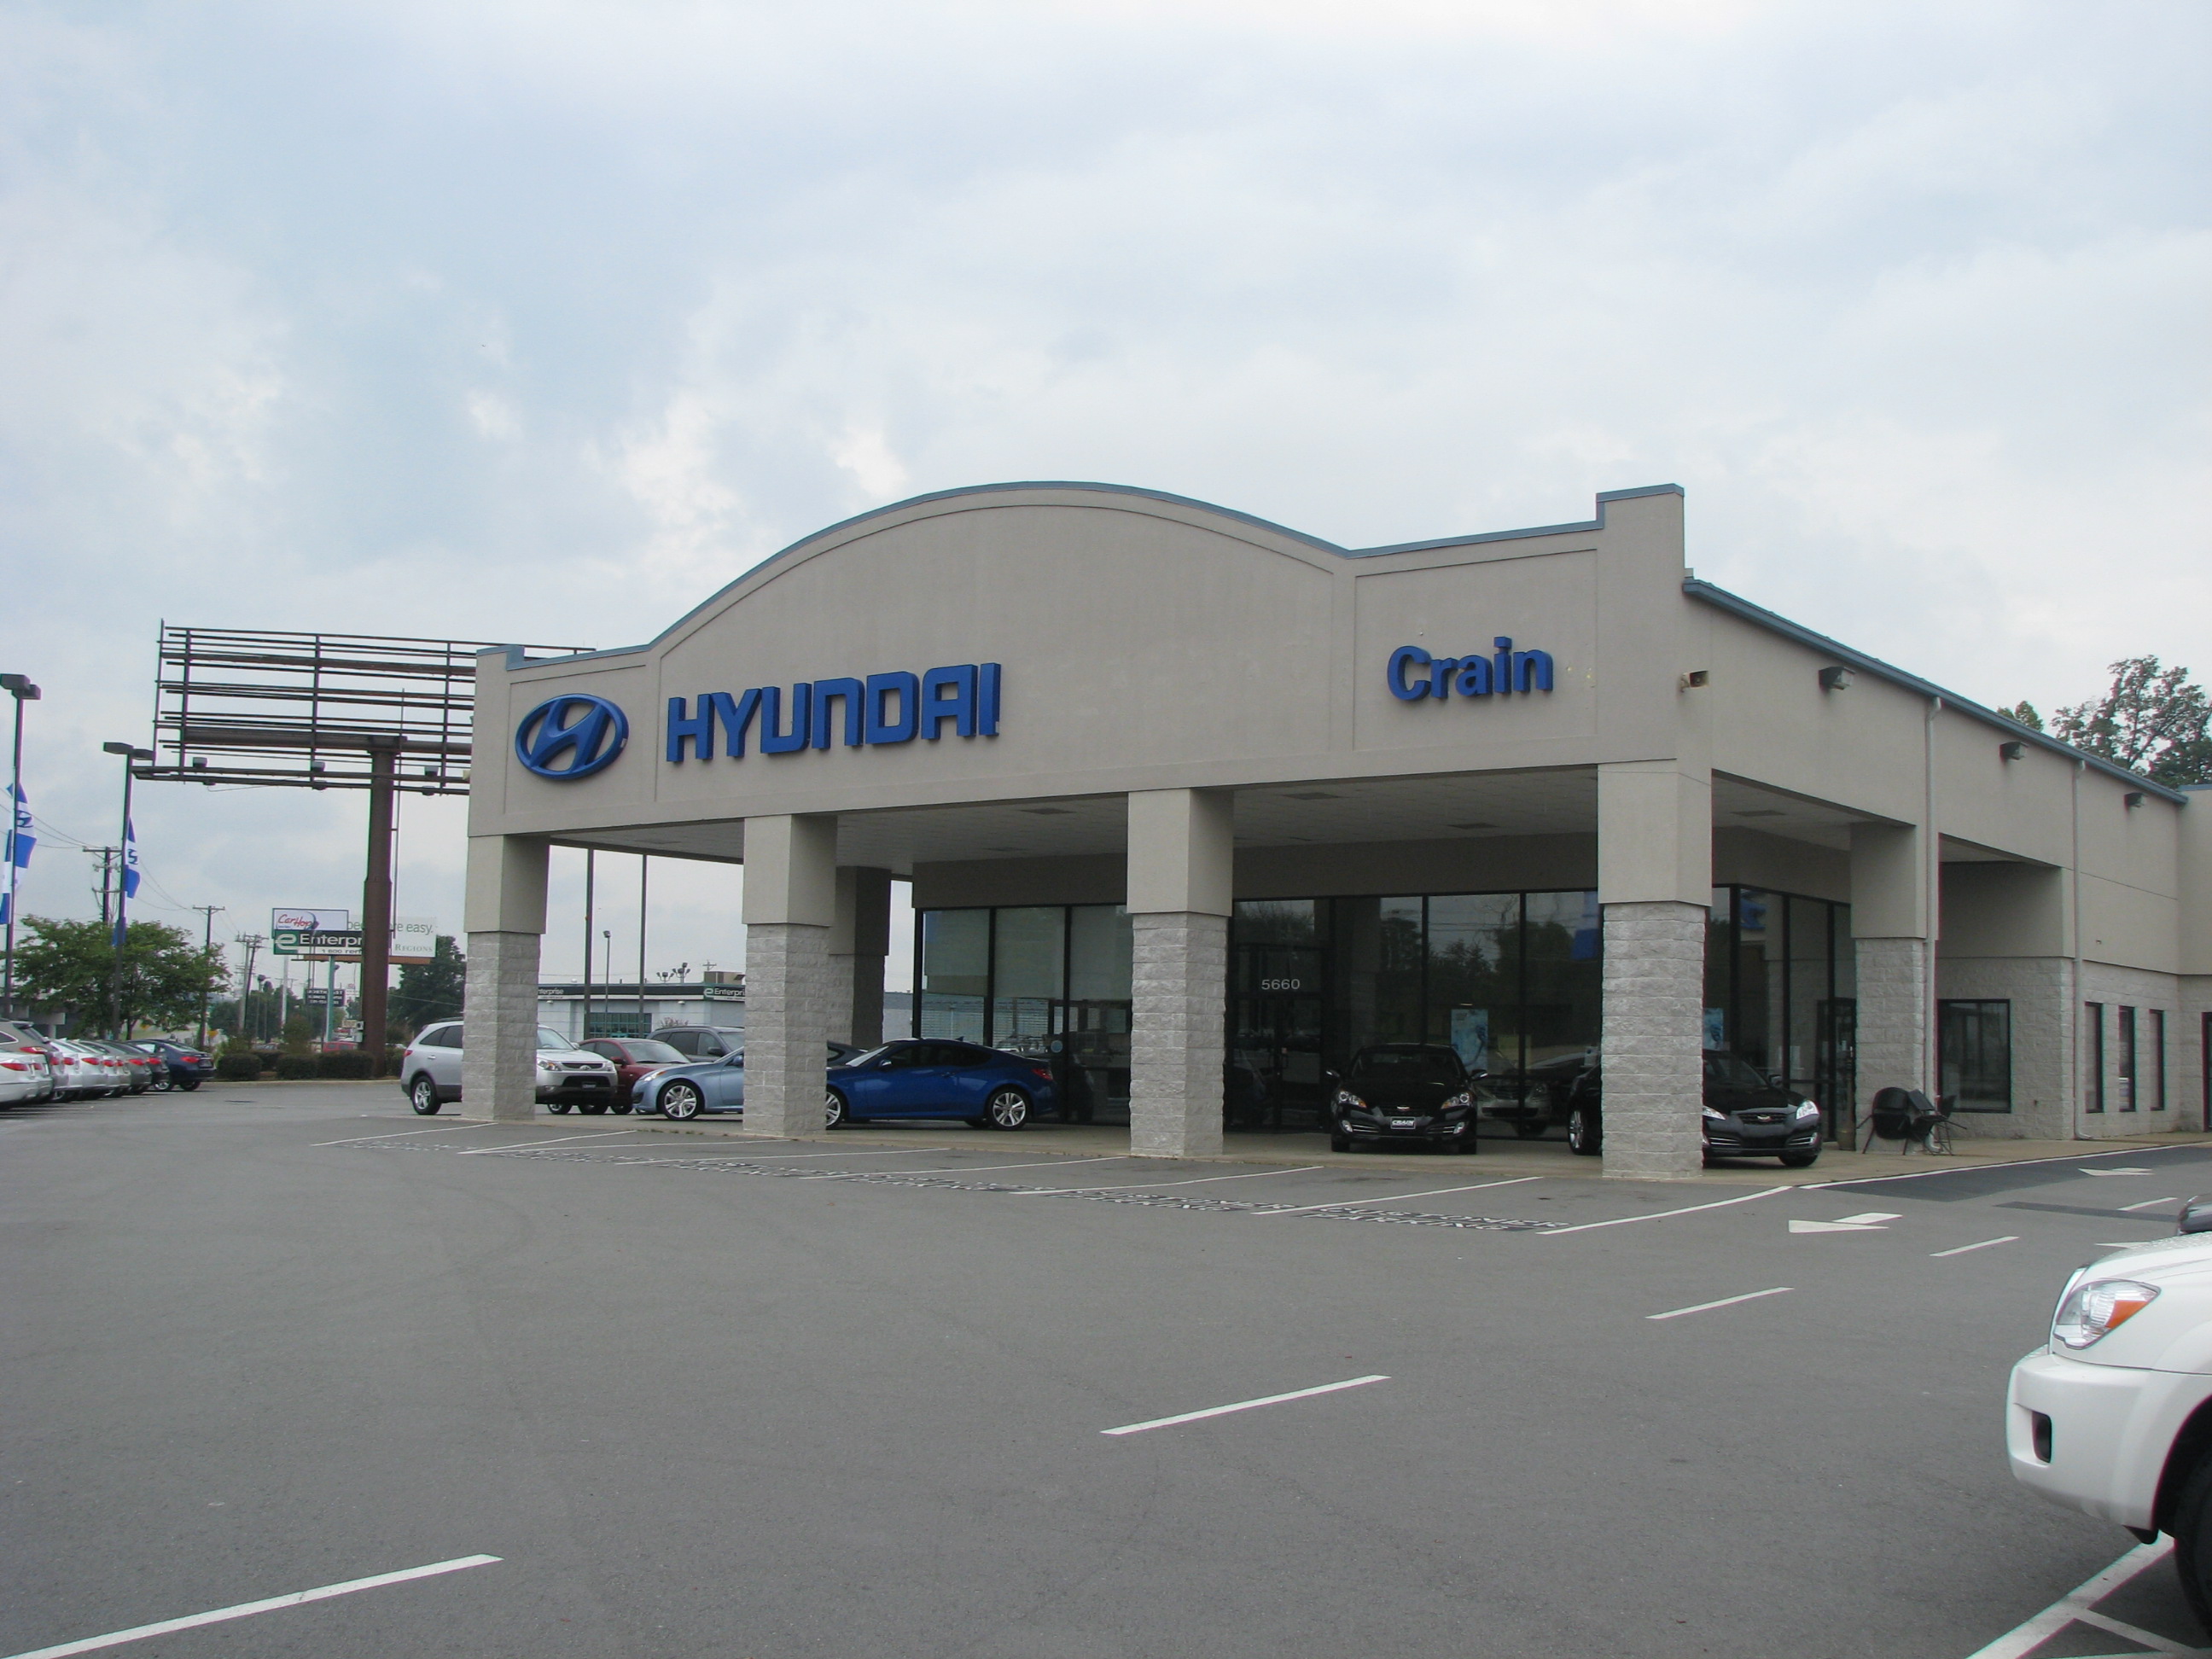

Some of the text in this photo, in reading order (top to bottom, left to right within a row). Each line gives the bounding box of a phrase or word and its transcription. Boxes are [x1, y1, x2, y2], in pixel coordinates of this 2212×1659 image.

[1387, 637, 1553, 701] Crain
[667, 662, 1001, 763] HYUNDAI
[300, 934, 362, 947] Enterpr
[1261, 979, 1301, 990] 5660
[714, 987, 745, 996] Enterpri
